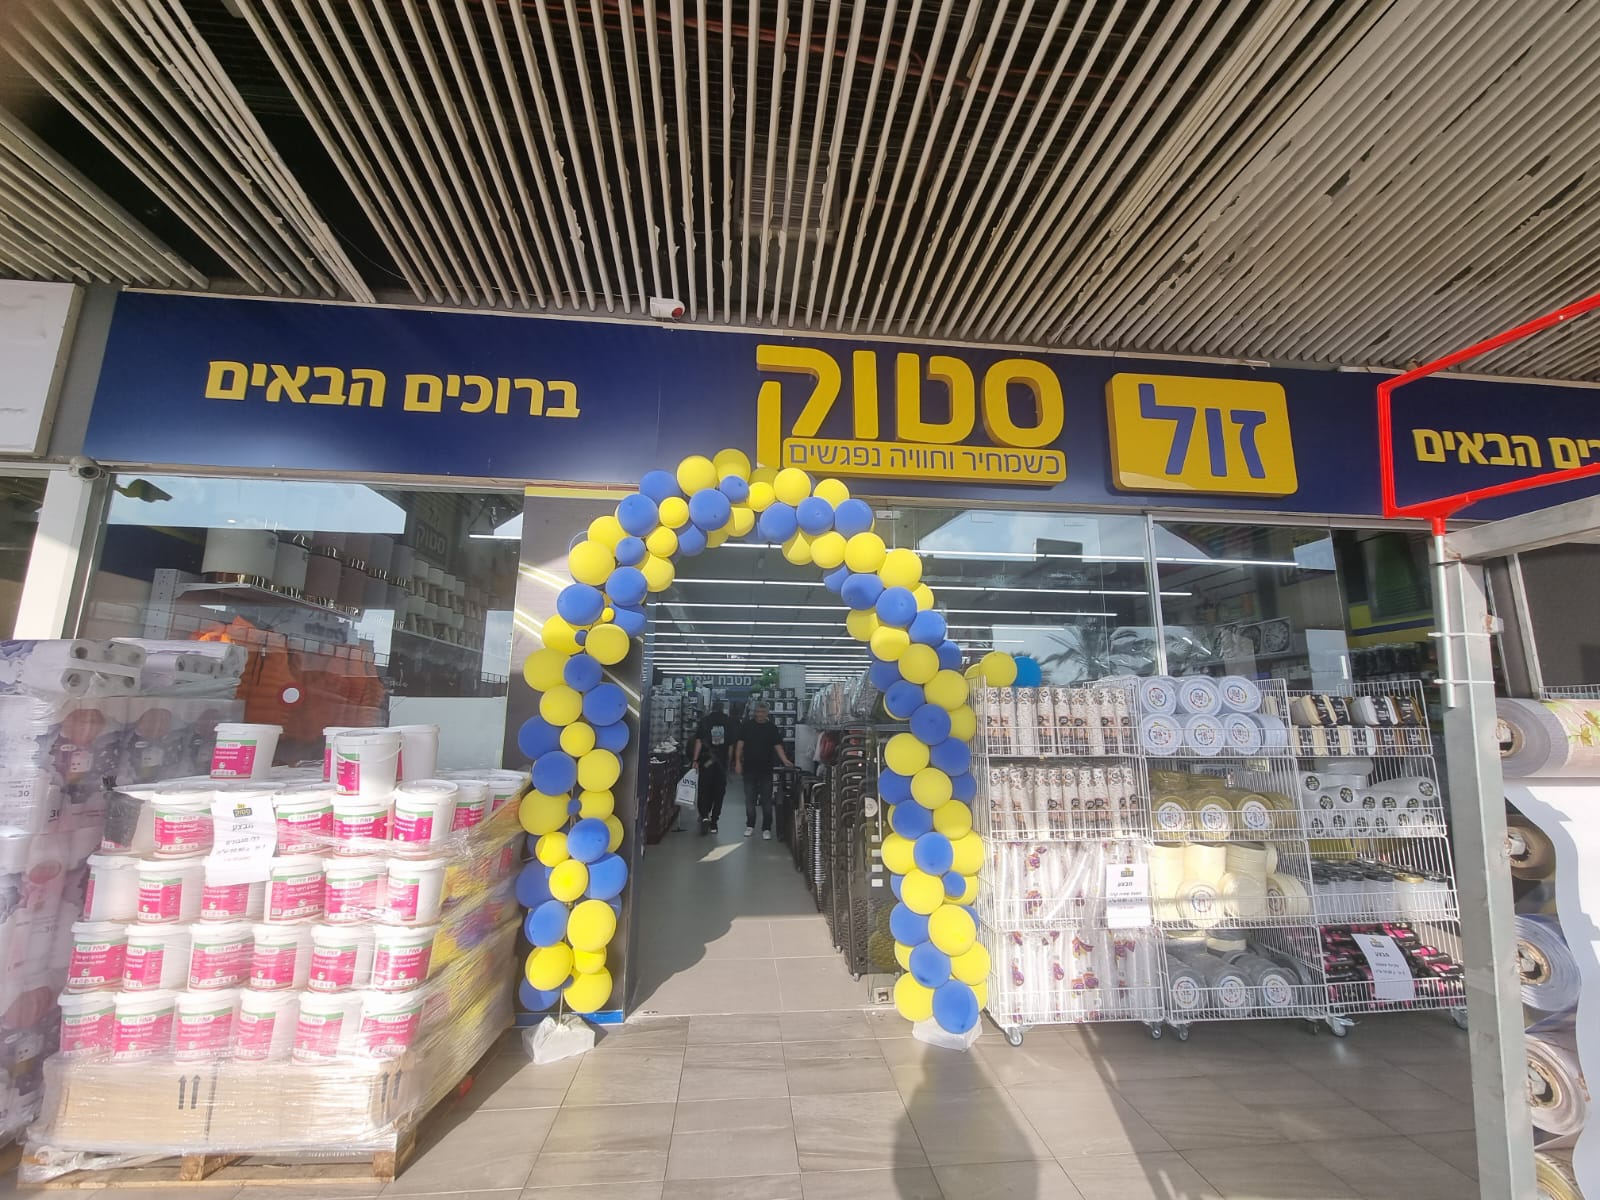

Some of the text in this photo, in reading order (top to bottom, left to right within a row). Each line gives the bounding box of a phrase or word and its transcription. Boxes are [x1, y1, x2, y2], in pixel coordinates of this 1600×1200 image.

[204, 360, 581, 418] ברוכים הבאים
[756, 344, 1267, 479] זול סטוק
[789, 443, 1060, 475] כשמחיר וחוויה נפגשים
[1411, 428, 1542, 468] הבאים
[718, 676, 752, 686] מטבח
